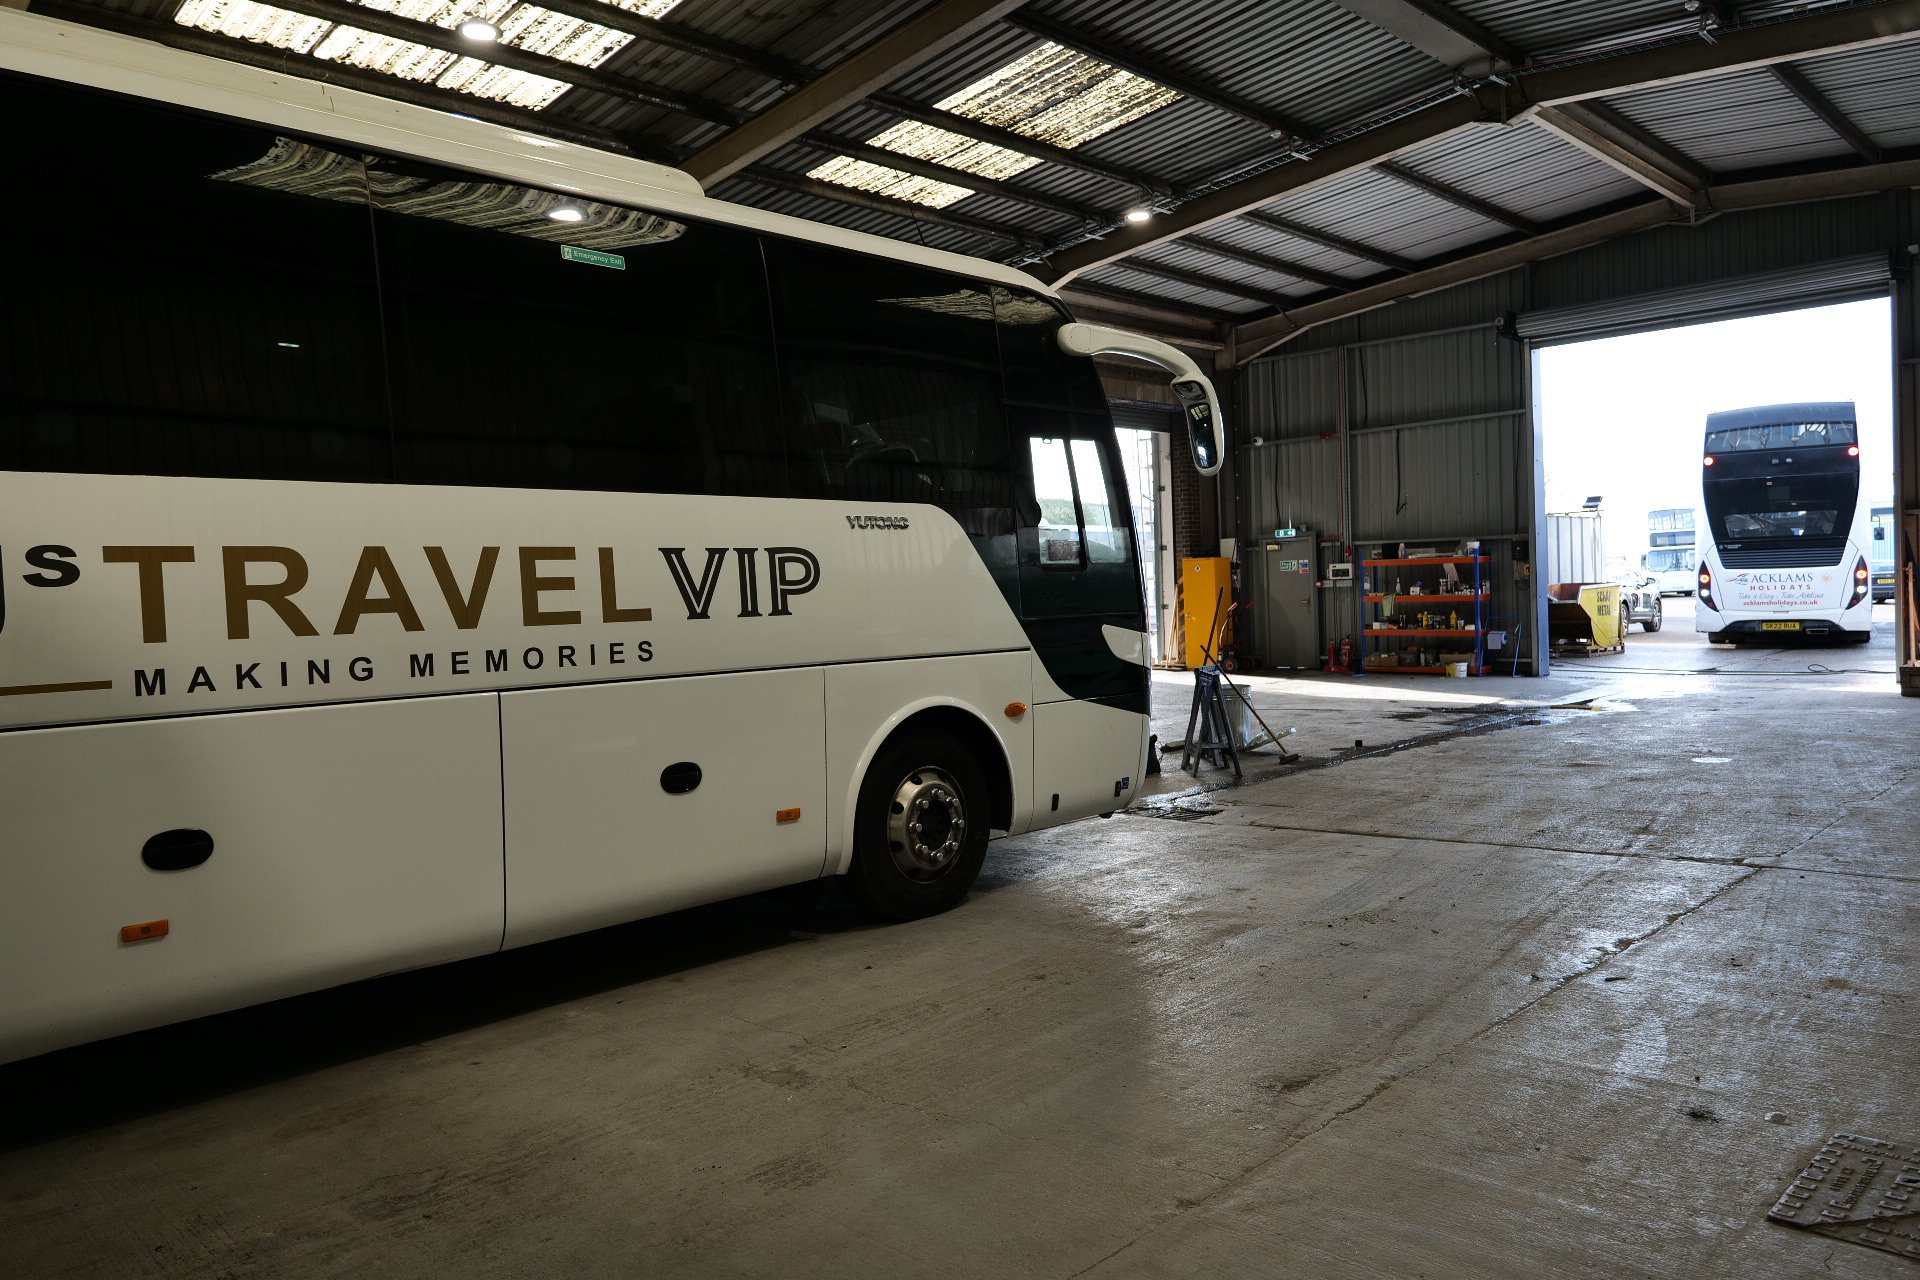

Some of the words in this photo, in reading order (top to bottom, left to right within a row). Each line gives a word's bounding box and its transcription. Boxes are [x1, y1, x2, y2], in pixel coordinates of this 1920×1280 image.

[573, 251, 608, 263] Emergency
[610, 257, 622, 265] Exit
[846, 515, 910, 530] YUTONG
[1751, 573, 1813, 583] ACKLAMS
[102, 545, 653, 644] TRAVEL
[660, 547, 820, 620] VIP
[1743, 599, 1818, 607] acklamsholidays.co.uk
[135, 656, 374, 698] MAKING
[409, 640, 655, 678] MEMORIES
